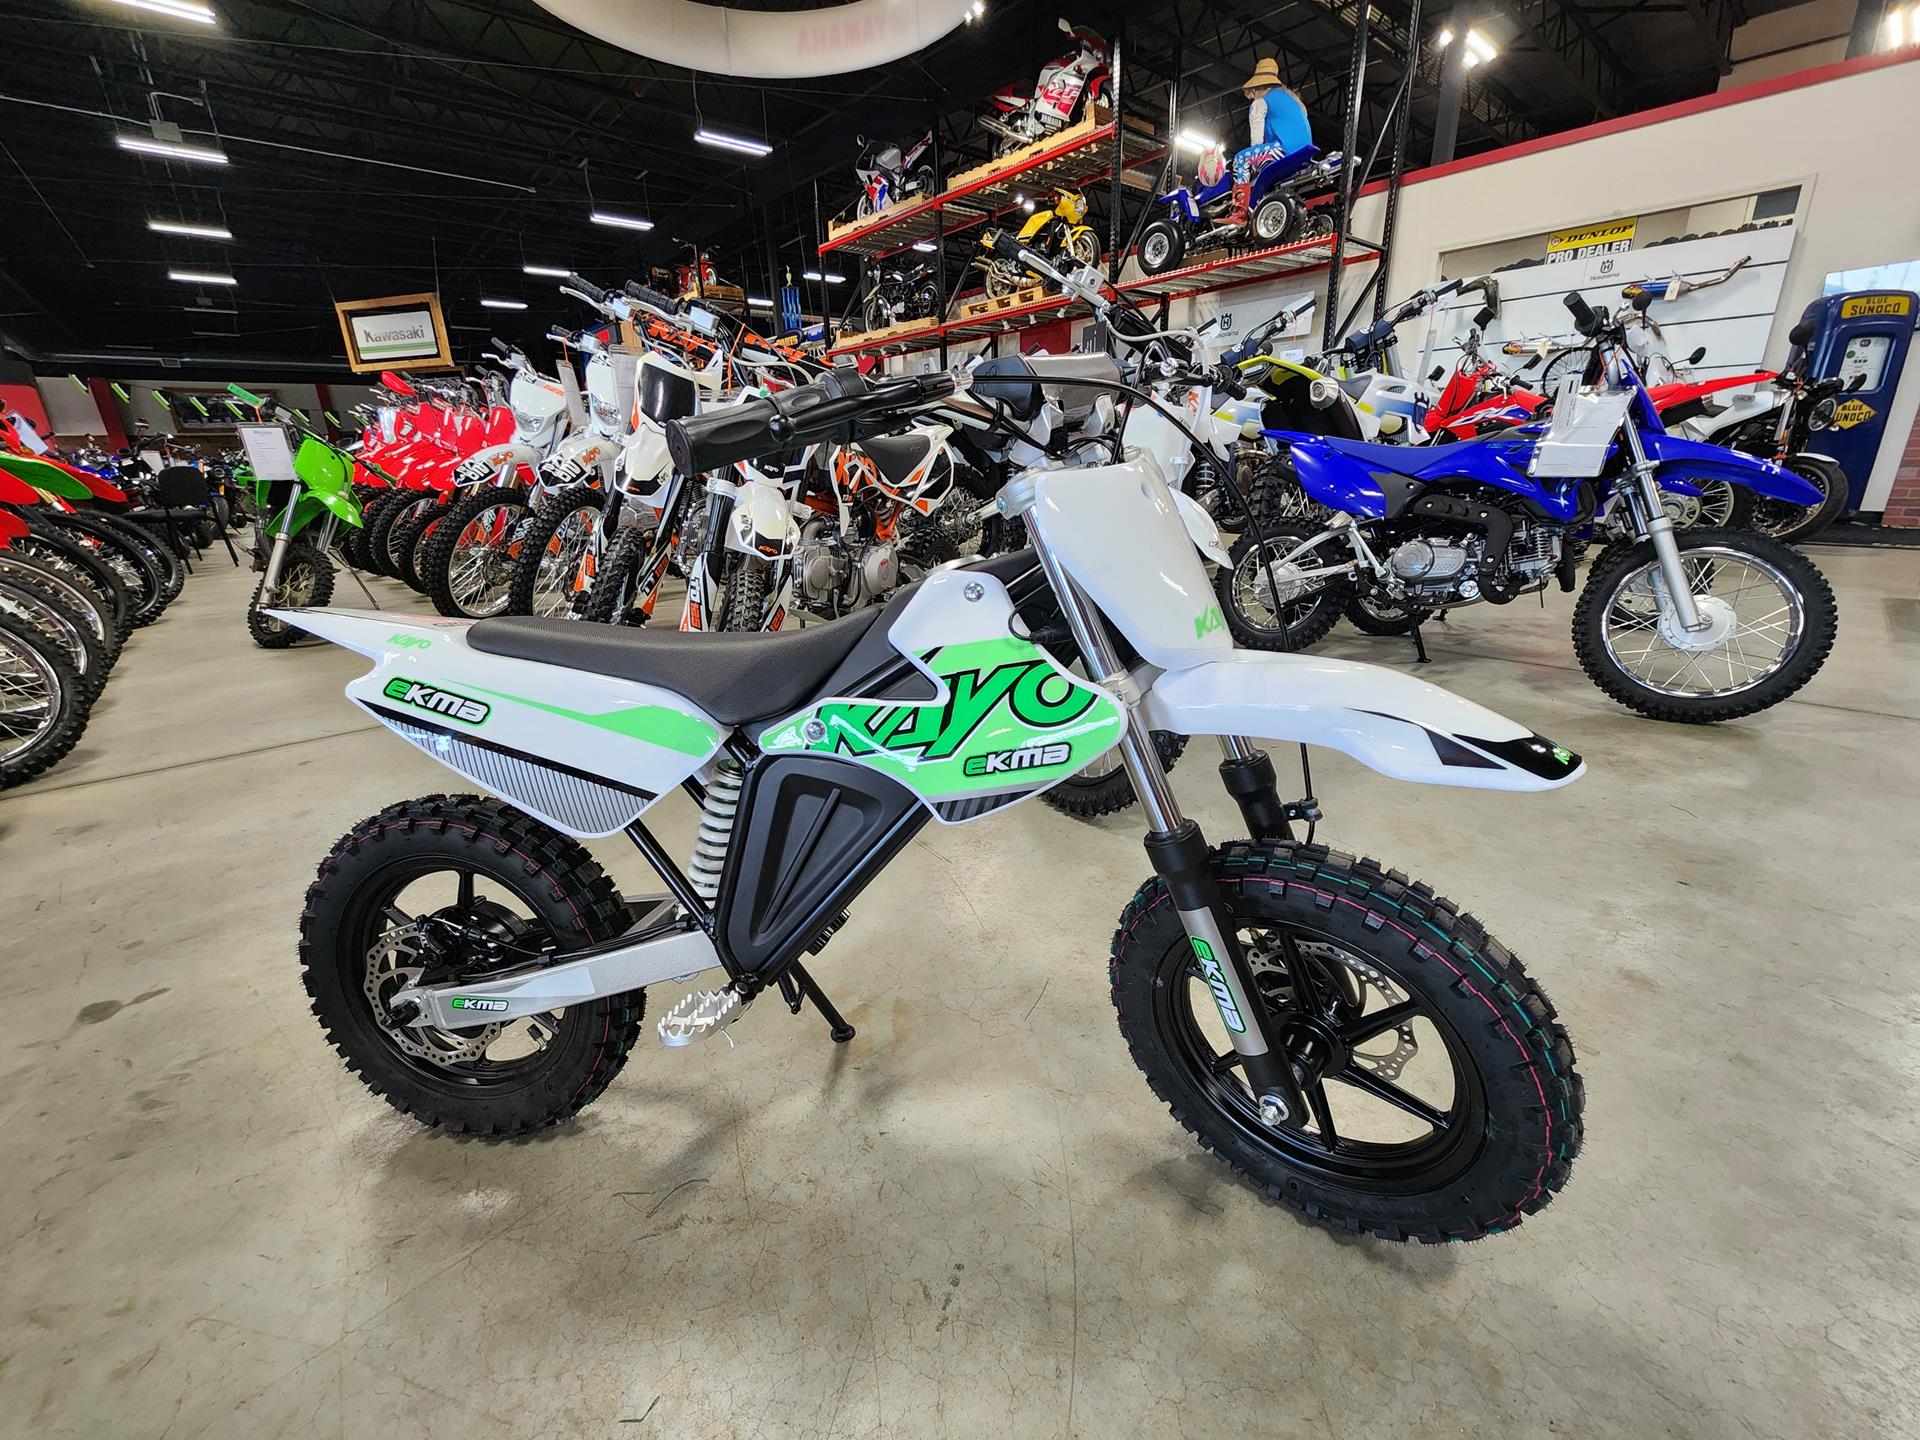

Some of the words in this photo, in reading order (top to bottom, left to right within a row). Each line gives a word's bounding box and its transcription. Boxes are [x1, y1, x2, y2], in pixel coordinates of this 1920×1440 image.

[1565, 224, 1634, 243] DUNLOP
[1546, 249, 1574, 264] PRO
[1577, 240, 1631, 260] DEALER
[1850, 303, 1901, 316] SUNOCO
[1865, 297, 1889, 305] BLUE
[363, 325, 425, 343] Kawasaki
[1841, 403, 1863, 412] BLUE
[1835, 411, 1872, 422] UNOCO
[387, 633, 432, 650] Kayo
[819, 655, 1097, 759] KAYO
